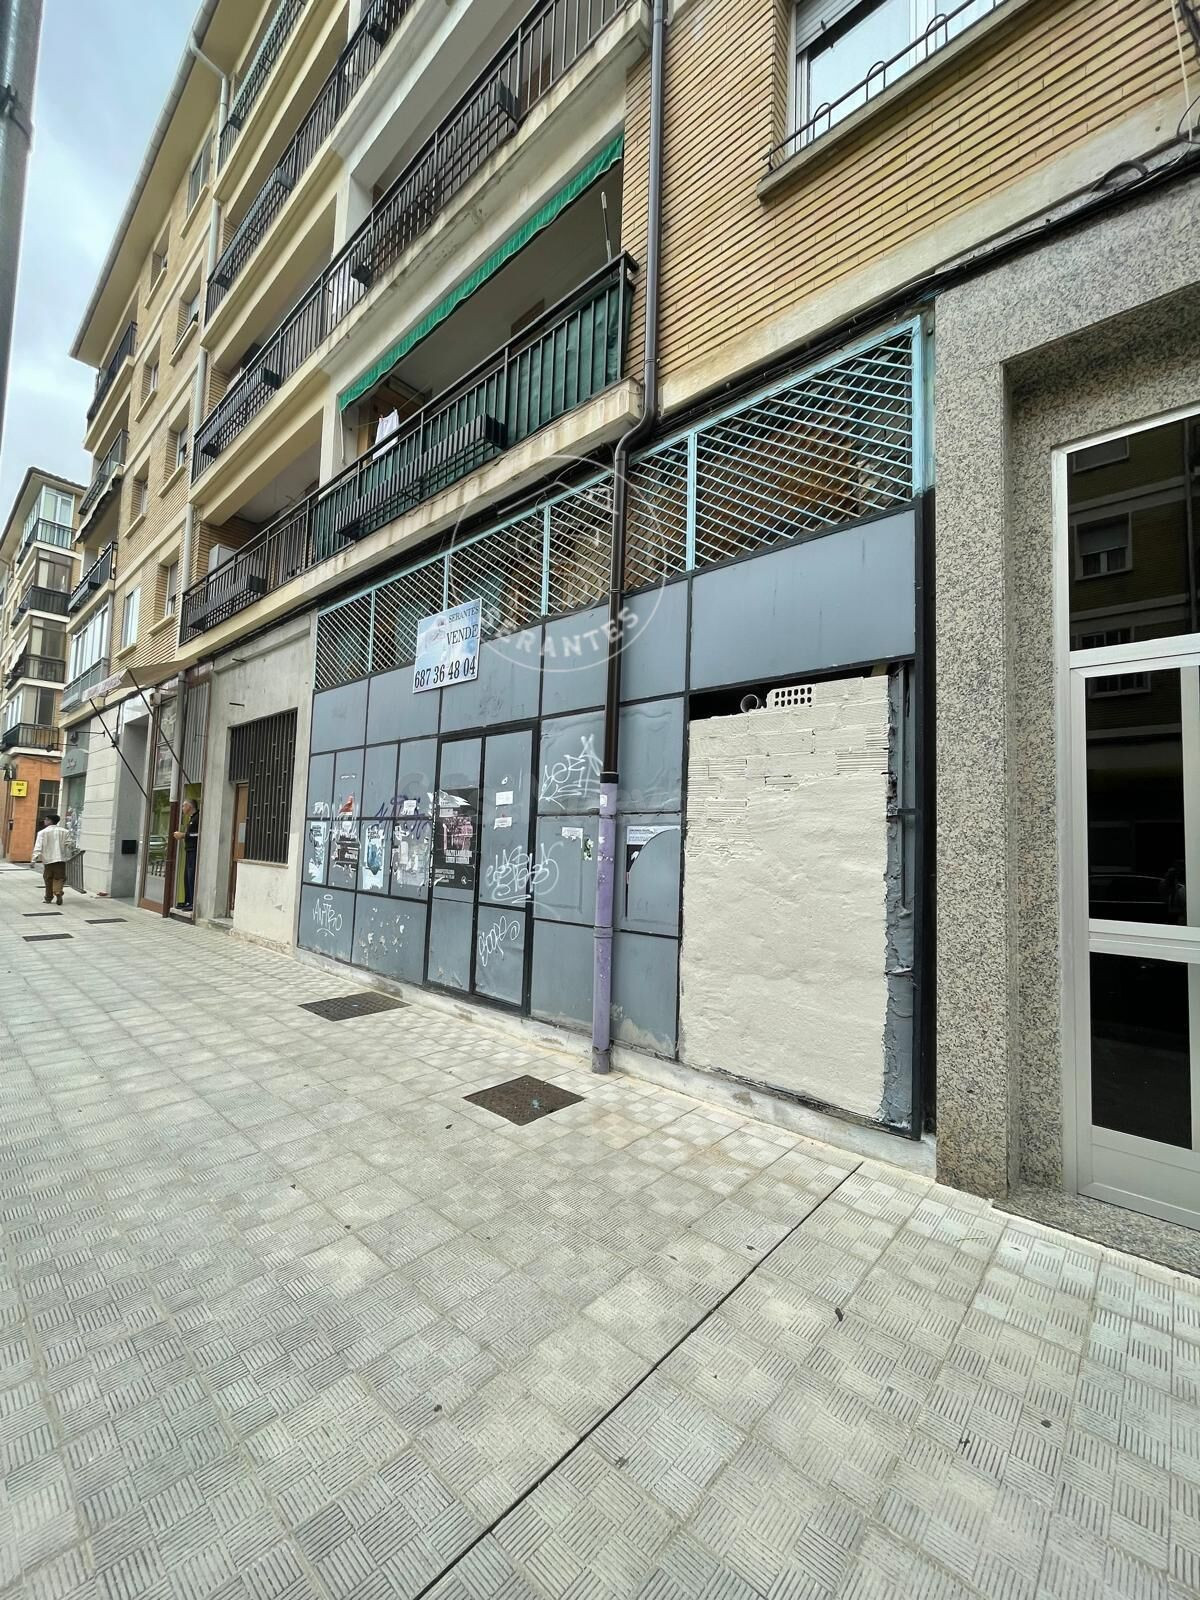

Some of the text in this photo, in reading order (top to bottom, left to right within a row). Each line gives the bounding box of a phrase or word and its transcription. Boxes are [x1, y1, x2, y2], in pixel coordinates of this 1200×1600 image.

[448, 606, 480, 623] SERANTES
[446, 624, 479, 645] VENDE
[414, 656, 476, 688] 687 36 48 04
